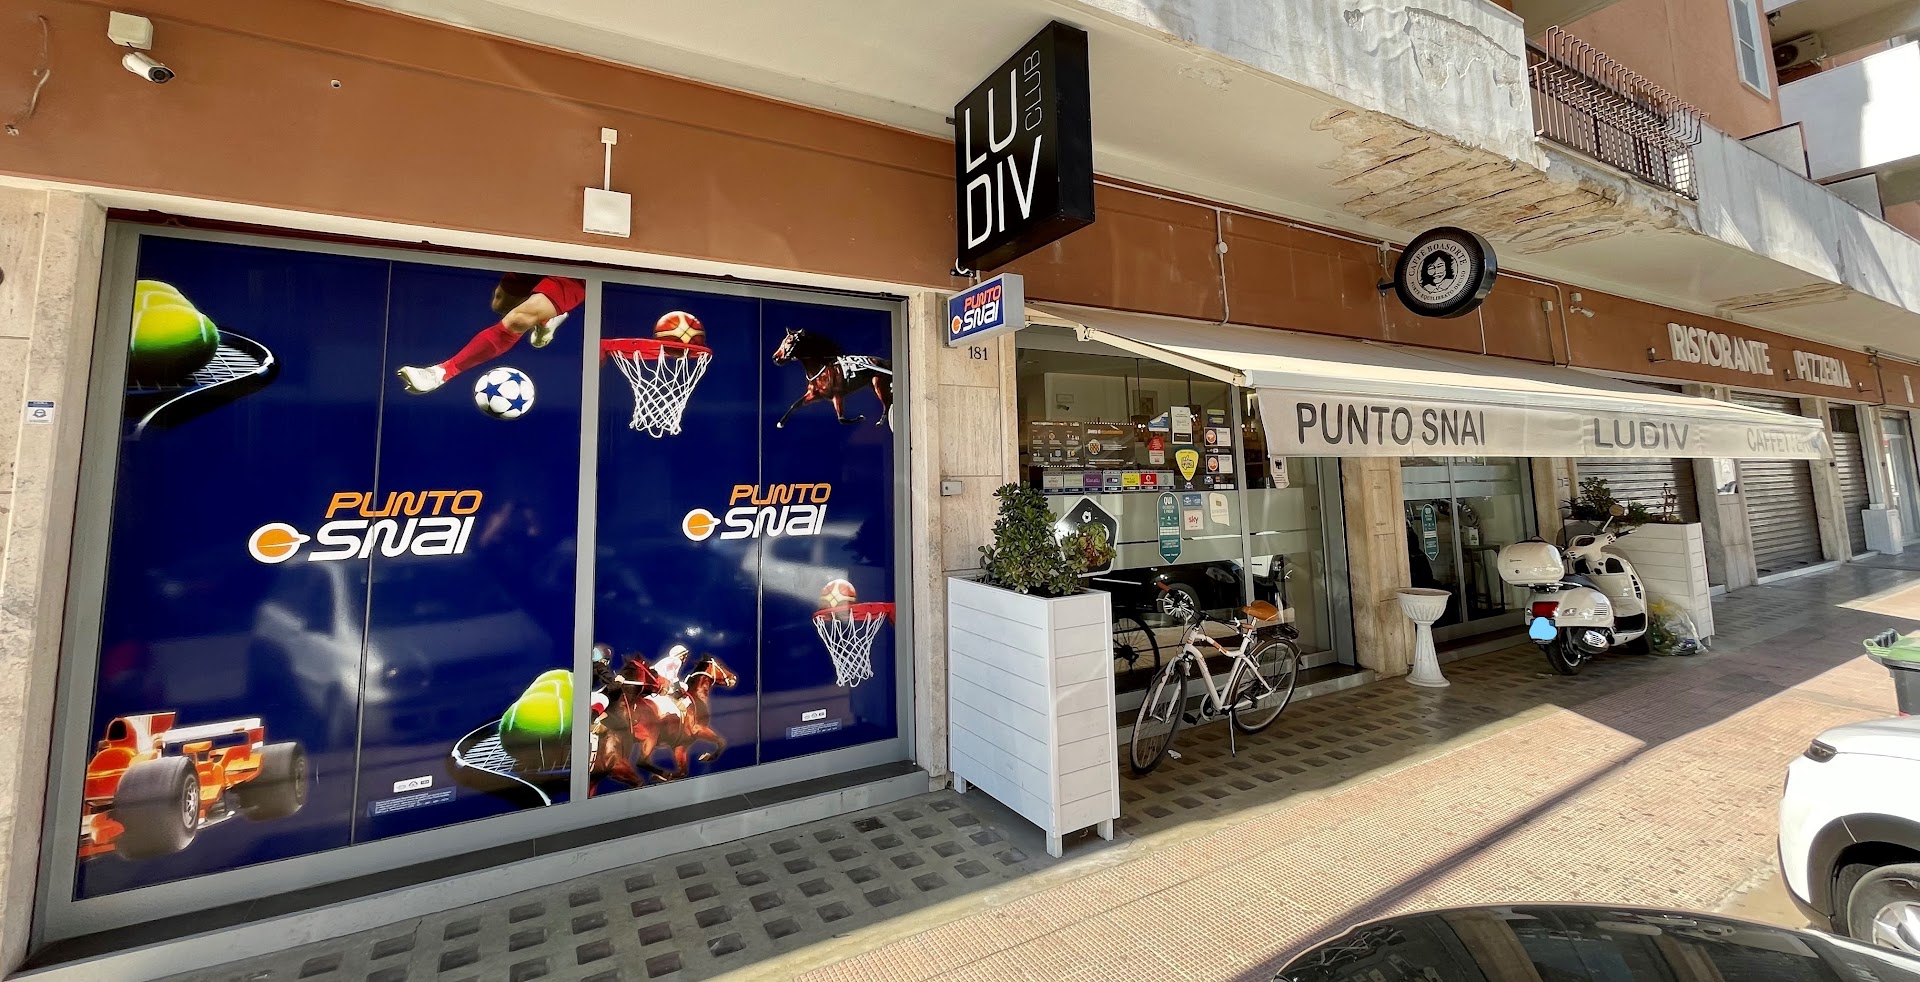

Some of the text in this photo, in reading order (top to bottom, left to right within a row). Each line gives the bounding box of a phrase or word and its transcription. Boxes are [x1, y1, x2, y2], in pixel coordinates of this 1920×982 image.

[1023, 49, 1041, 132] CLUB
[965, 67, 1017, 174] LU
[966, 134, 1042, 250] DIV
[963, 284, 1002, 312] PUNTO
[968, 345, 988, 361] 181
[1667, 322, 1852, 389] RISTORANTE PIZZERIA
[1296, 402, 1413, 445] PUNTO
[1421, 408, 1486, 446] SNAI
[1593, 417, 1689, 451] LUDIV
[324, 489, 483, 519] PUNTO
[728, 482, 832, 506] PUNTO
[1188, 515, 1199, 525] sky
